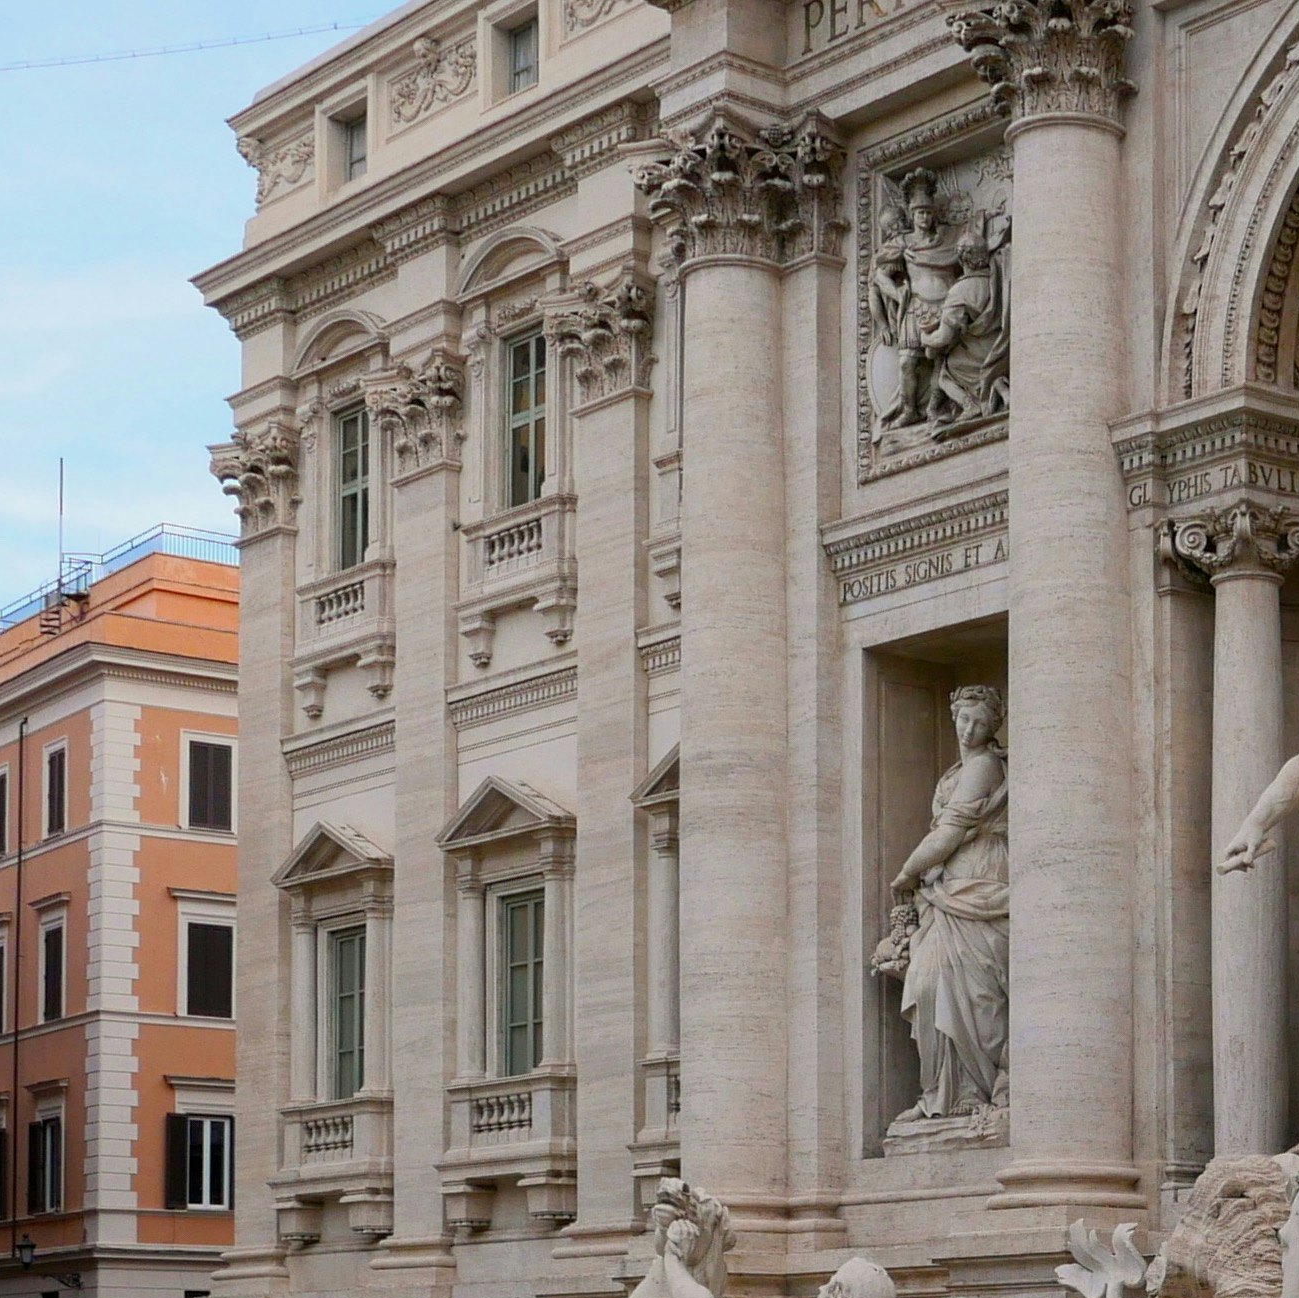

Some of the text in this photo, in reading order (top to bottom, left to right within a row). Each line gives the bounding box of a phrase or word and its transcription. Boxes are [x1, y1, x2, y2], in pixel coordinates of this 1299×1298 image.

[801, 0, 906, 55] PER
[842, 569, 897, 602] POSITIS
[904, 552, 952, 585] SIGNIS
[963, 544, 983, 569] ET
